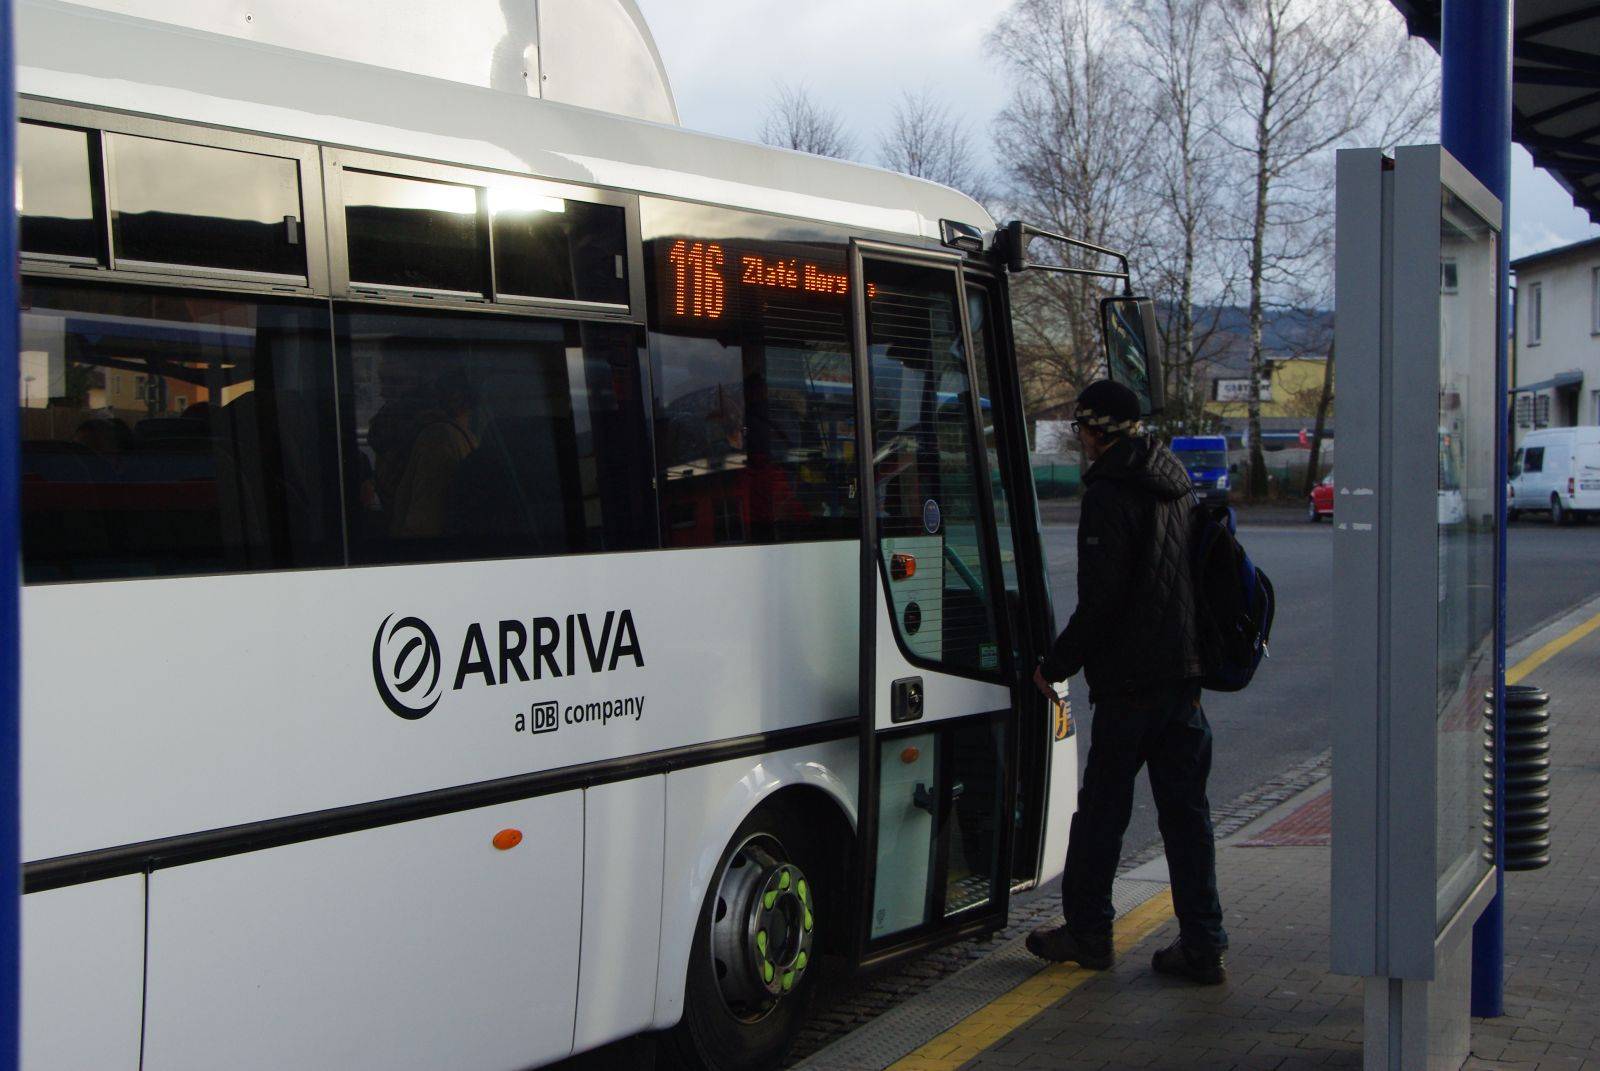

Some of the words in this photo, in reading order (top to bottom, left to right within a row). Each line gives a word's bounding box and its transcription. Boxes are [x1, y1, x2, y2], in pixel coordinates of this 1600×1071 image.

[669, 240, 724, 318] 116
[742, 257, 797, 288] Zlaté
[452, 608, 645, 690] ARRIVA
[514, 711, 526, 732] a
[532, 702, 558, 733] DB
[564, 695, 645, 725] company
